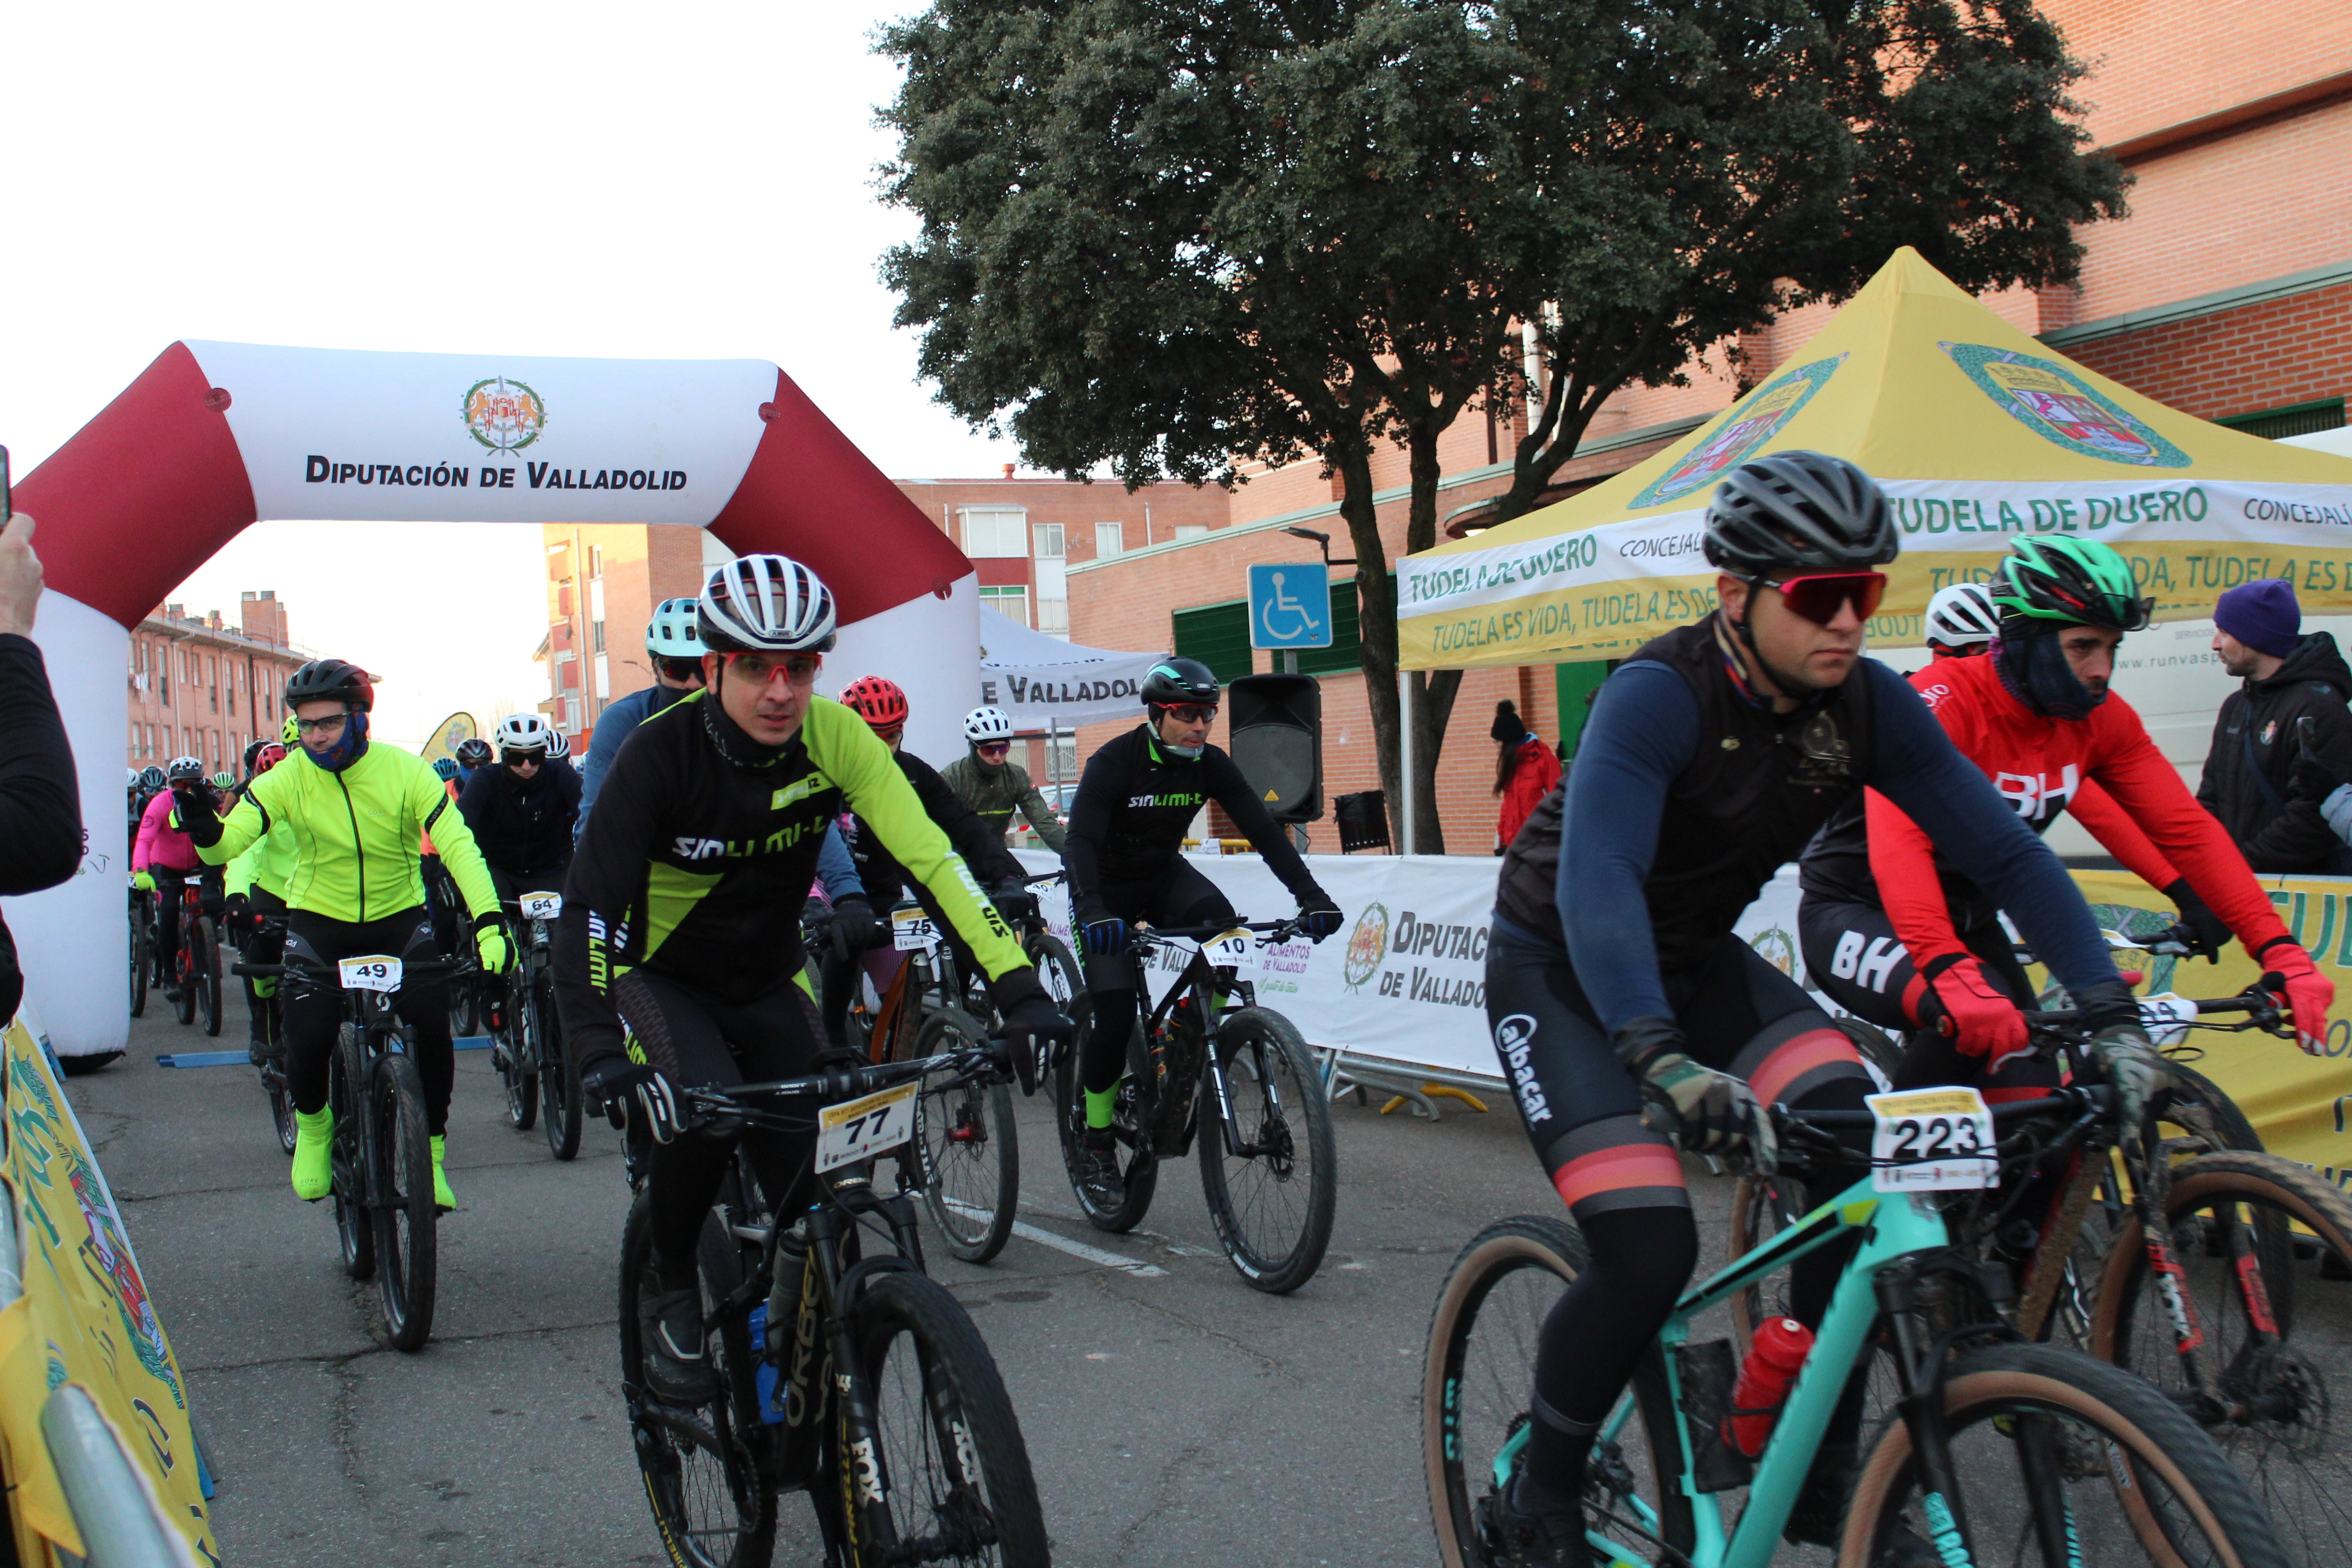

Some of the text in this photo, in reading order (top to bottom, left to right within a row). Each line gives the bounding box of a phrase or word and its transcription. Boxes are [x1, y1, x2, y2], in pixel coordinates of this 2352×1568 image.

[306, 455, 687, 490] DIPUTACIÓN DE VALLADOLID
[2027, 499, 2078, 532] DE
[2086, 486, 2208, 530] DUERO
[1409, 565, 1487, 603] TUDELA
[1519, 534, 1597, 581] DUERO
[2304, 560, 2337, 591] ES
[1432, 614, 1499, 653] TUDELA
[1502, 610, 1523, 642] ES
[1528, 601, 1576, 637] VIDA,
[1582, 591, 1659, 629] TUDELA
[1664, 590, 1691, 620] ES
[1993, 763, 2079, 820] BH
[532, 900, 553, 911] 64
[907, 918, 931, 936] 75
[1219, 937, 1245, 954] 10
[1392, 911, 1489, 962] DIPUTAC
[356, 964, 387, 978] 49
[1263, 959, 1307, 974] DE VALLADOLID
[1267, 943, 1311, 960] ALIMENTOS
[1830, 930, 1909, 994] BH
[1378, 966, 1488, 1009] DE VALLADO
[1501, 1025, 1553, 1123] albacar
[845, 1106, 891, 1146] 77
[1892, 1117, 1980, 1159] 223
[851, 1436, 885, 1509] FOX
